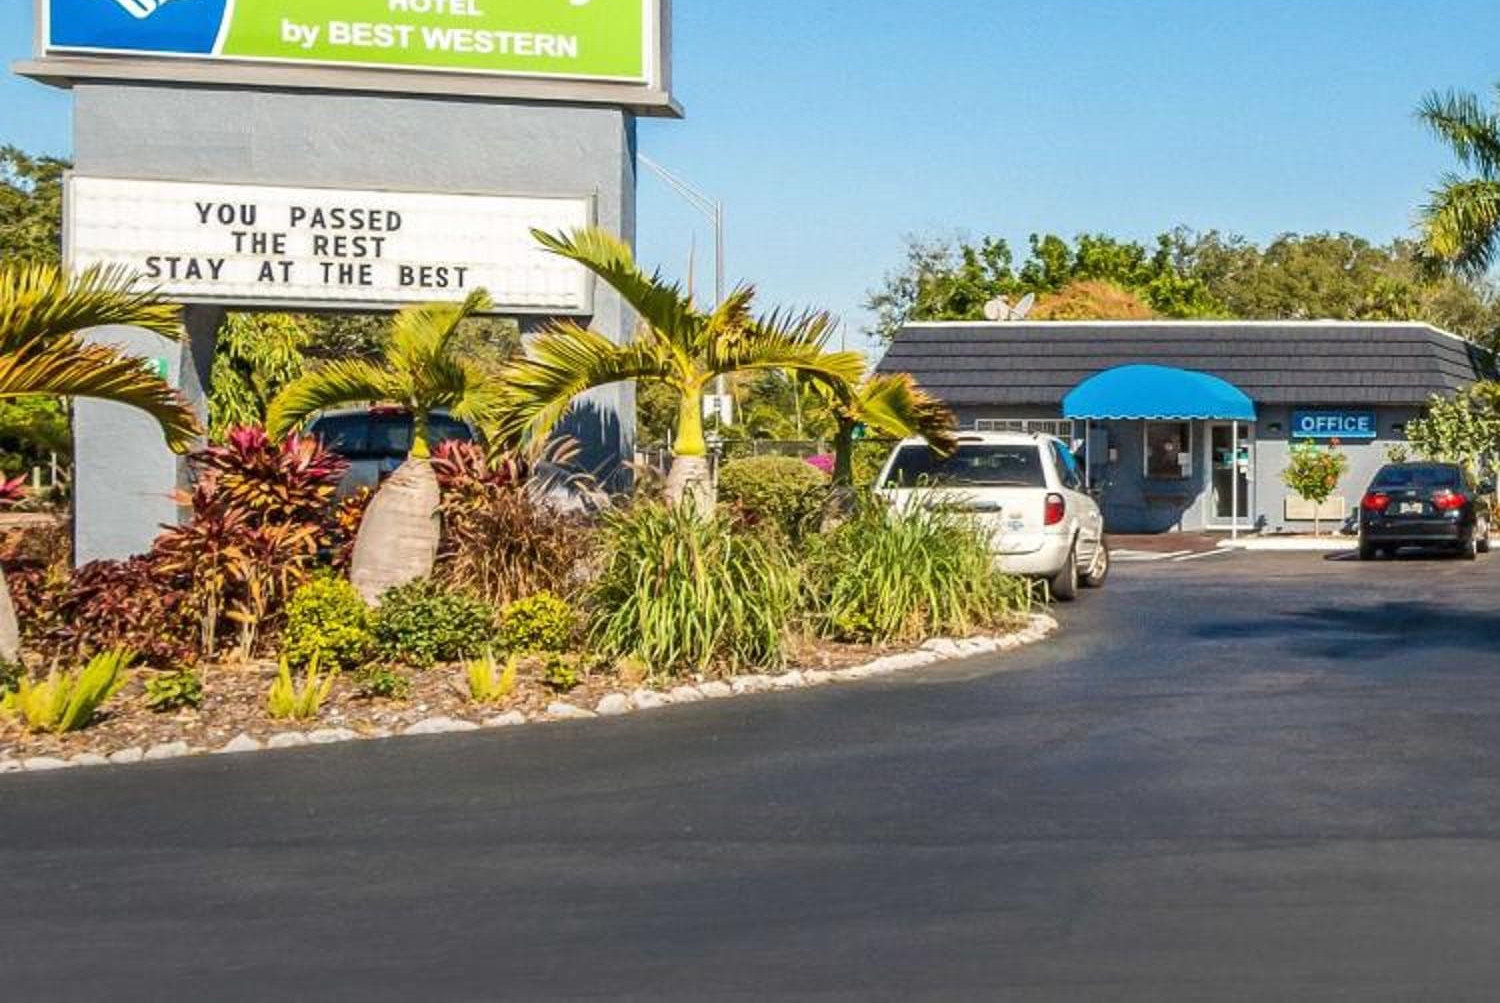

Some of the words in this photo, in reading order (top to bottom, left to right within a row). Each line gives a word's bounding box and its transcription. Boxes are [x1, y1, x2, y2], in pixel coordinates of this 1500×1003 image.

[280, 18, 321, 49] by
[328, 20, 413, 48] BEST
[421, 26, 578, 58] WESTERN
[195, 202, 257, 226] YOU
[289, 206, 403, 232] PASSED
[231, 231, 287, 254] THE
[312, 234, 386, 258] REST
[145, 256, 225, 280] STAY
[257, 260, 295, 282] AT
[320, 262, 374, 286] THE
[399, 265, 469, 288] BEST
[1301, 415, 1370, 431] OFFICE
